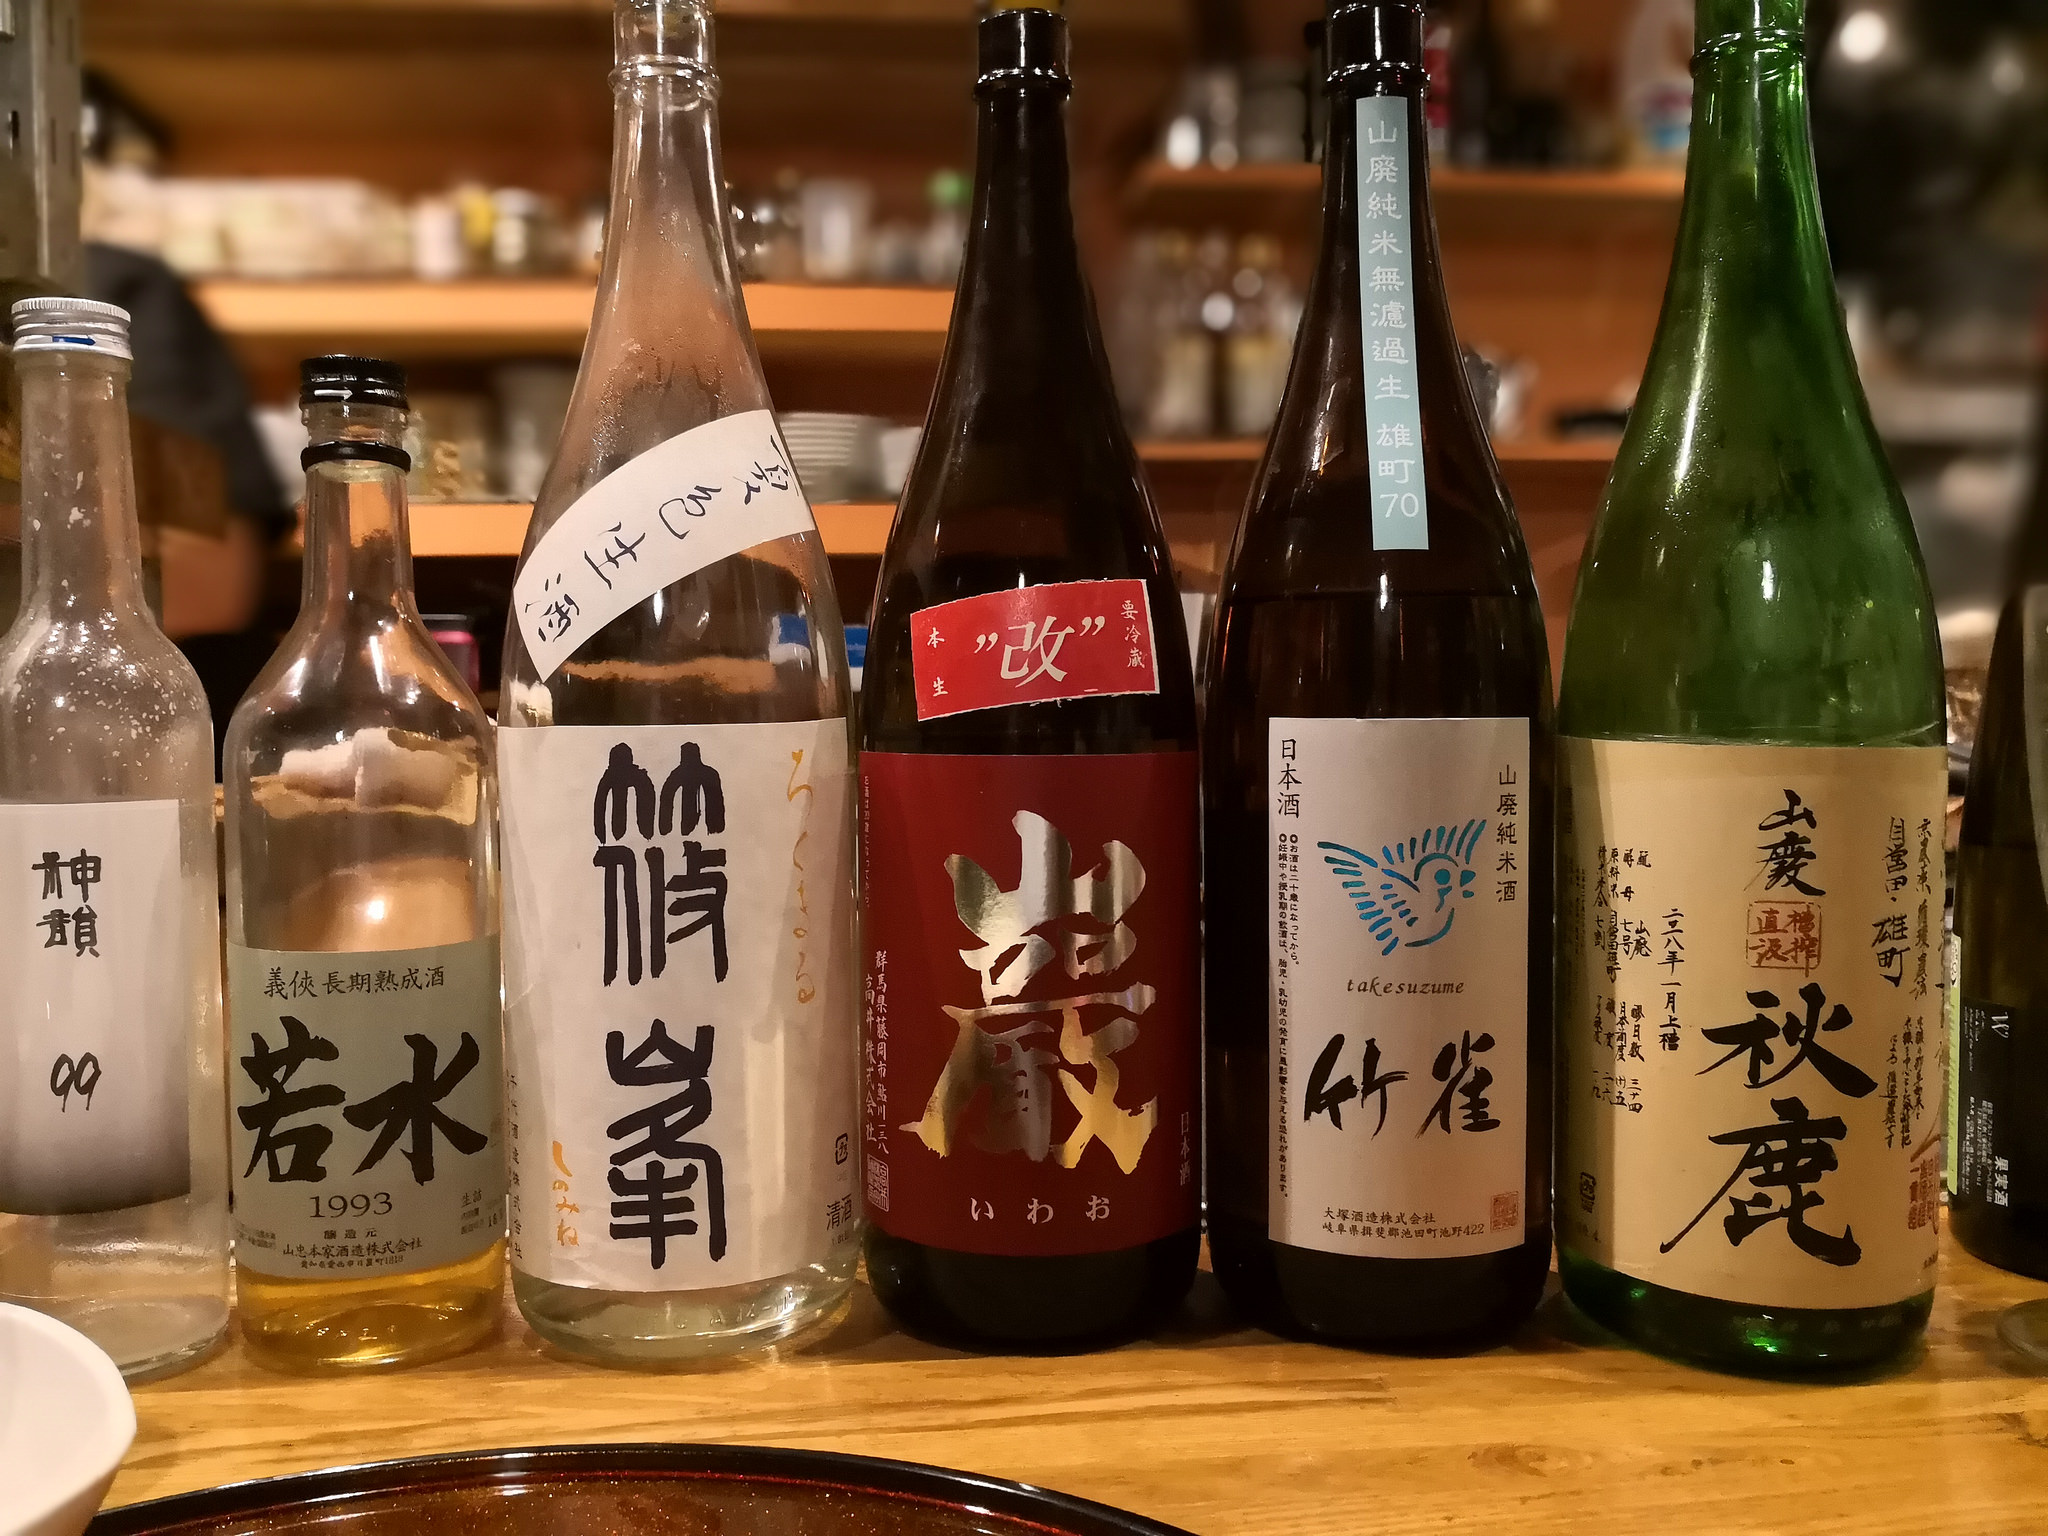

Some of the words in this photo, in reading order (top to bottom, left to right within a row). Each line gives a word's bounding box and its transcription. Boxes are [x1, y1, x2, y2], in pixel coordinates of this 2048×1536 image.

[1366, 118, 1410, 402] 山廃純米無濾過生
[926, 626, 949, 698] 本生
[1119, 599, 1146, 669] 要冷蔵
[1276, 738, 1301, 819] 日本酒
[1495, 763, 1519, 903] 山廃純米酒
[1347, 975, 1466, 998] takesuzume
[237, 1014, 489, 1187] 若水
[1303, 1030, 1501, 1140] 竹雀
[1658, 980, 1879, 1267] 秋鹿
[309, 1191, 394, 1219] 1993
[826, 1193, 852, 1231] 清酒
[970, 1195, 1111, 1226] いわお
[1323, 1206, 1437, 1224] 大塚酒造株式会社
[282, 1237, 423, 1258] 山忠本家酒造株式会社
